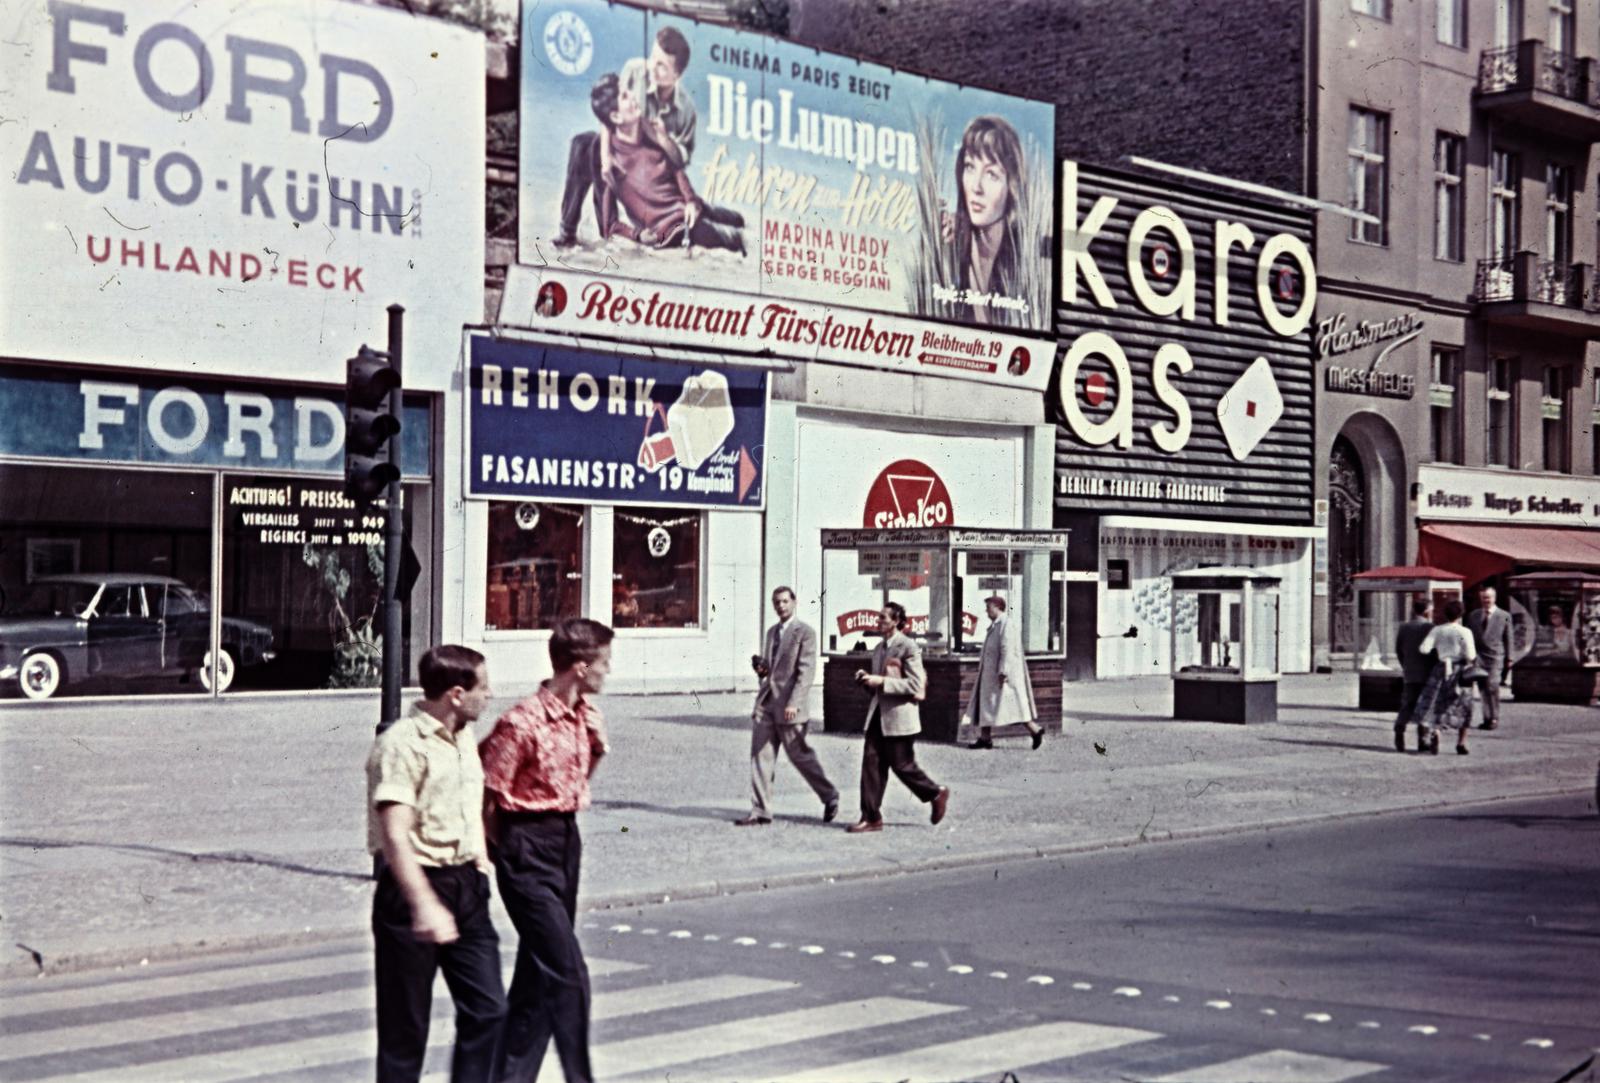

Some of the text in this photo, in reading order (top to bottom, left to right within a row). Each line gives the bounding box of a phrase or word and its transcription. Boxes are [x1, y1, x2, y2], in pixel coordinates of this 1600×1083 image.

[47, 0, 394, 144] FORD
[709, 44, 892, 101] CINEMA PARIS ZEIGT
[706, 73, 920, 175] Die Lumpen
[703, 144, 818, 214] fahren
[763, 244, 889, 276] HENRI VIDAL
[764, 219, 889, 258] MARINA VLADY
[1062, 160, 1317, 336] karo
[764, 260, 892, 292] SERGE REGGIANI
[576, 281, 915, 359] Restaurant Fürstenborn
[988, 340, 1003, 359] 19
[482, 364, 656, 417] REHORK
[1060, 331, 1194, 454] as
[79, 380, 346, 461] FORD
[230, 485, 291, 506] ACHTUNG!
[658, 466, 683, 492] 19
[1060, 475, 1105, 497] BERLINS
[1166, 482, 1226, 503] FAHRSCHULE
[242, 513, 299, 527] VERSAILLES
[874, 498, 947, 529] Sinalco
